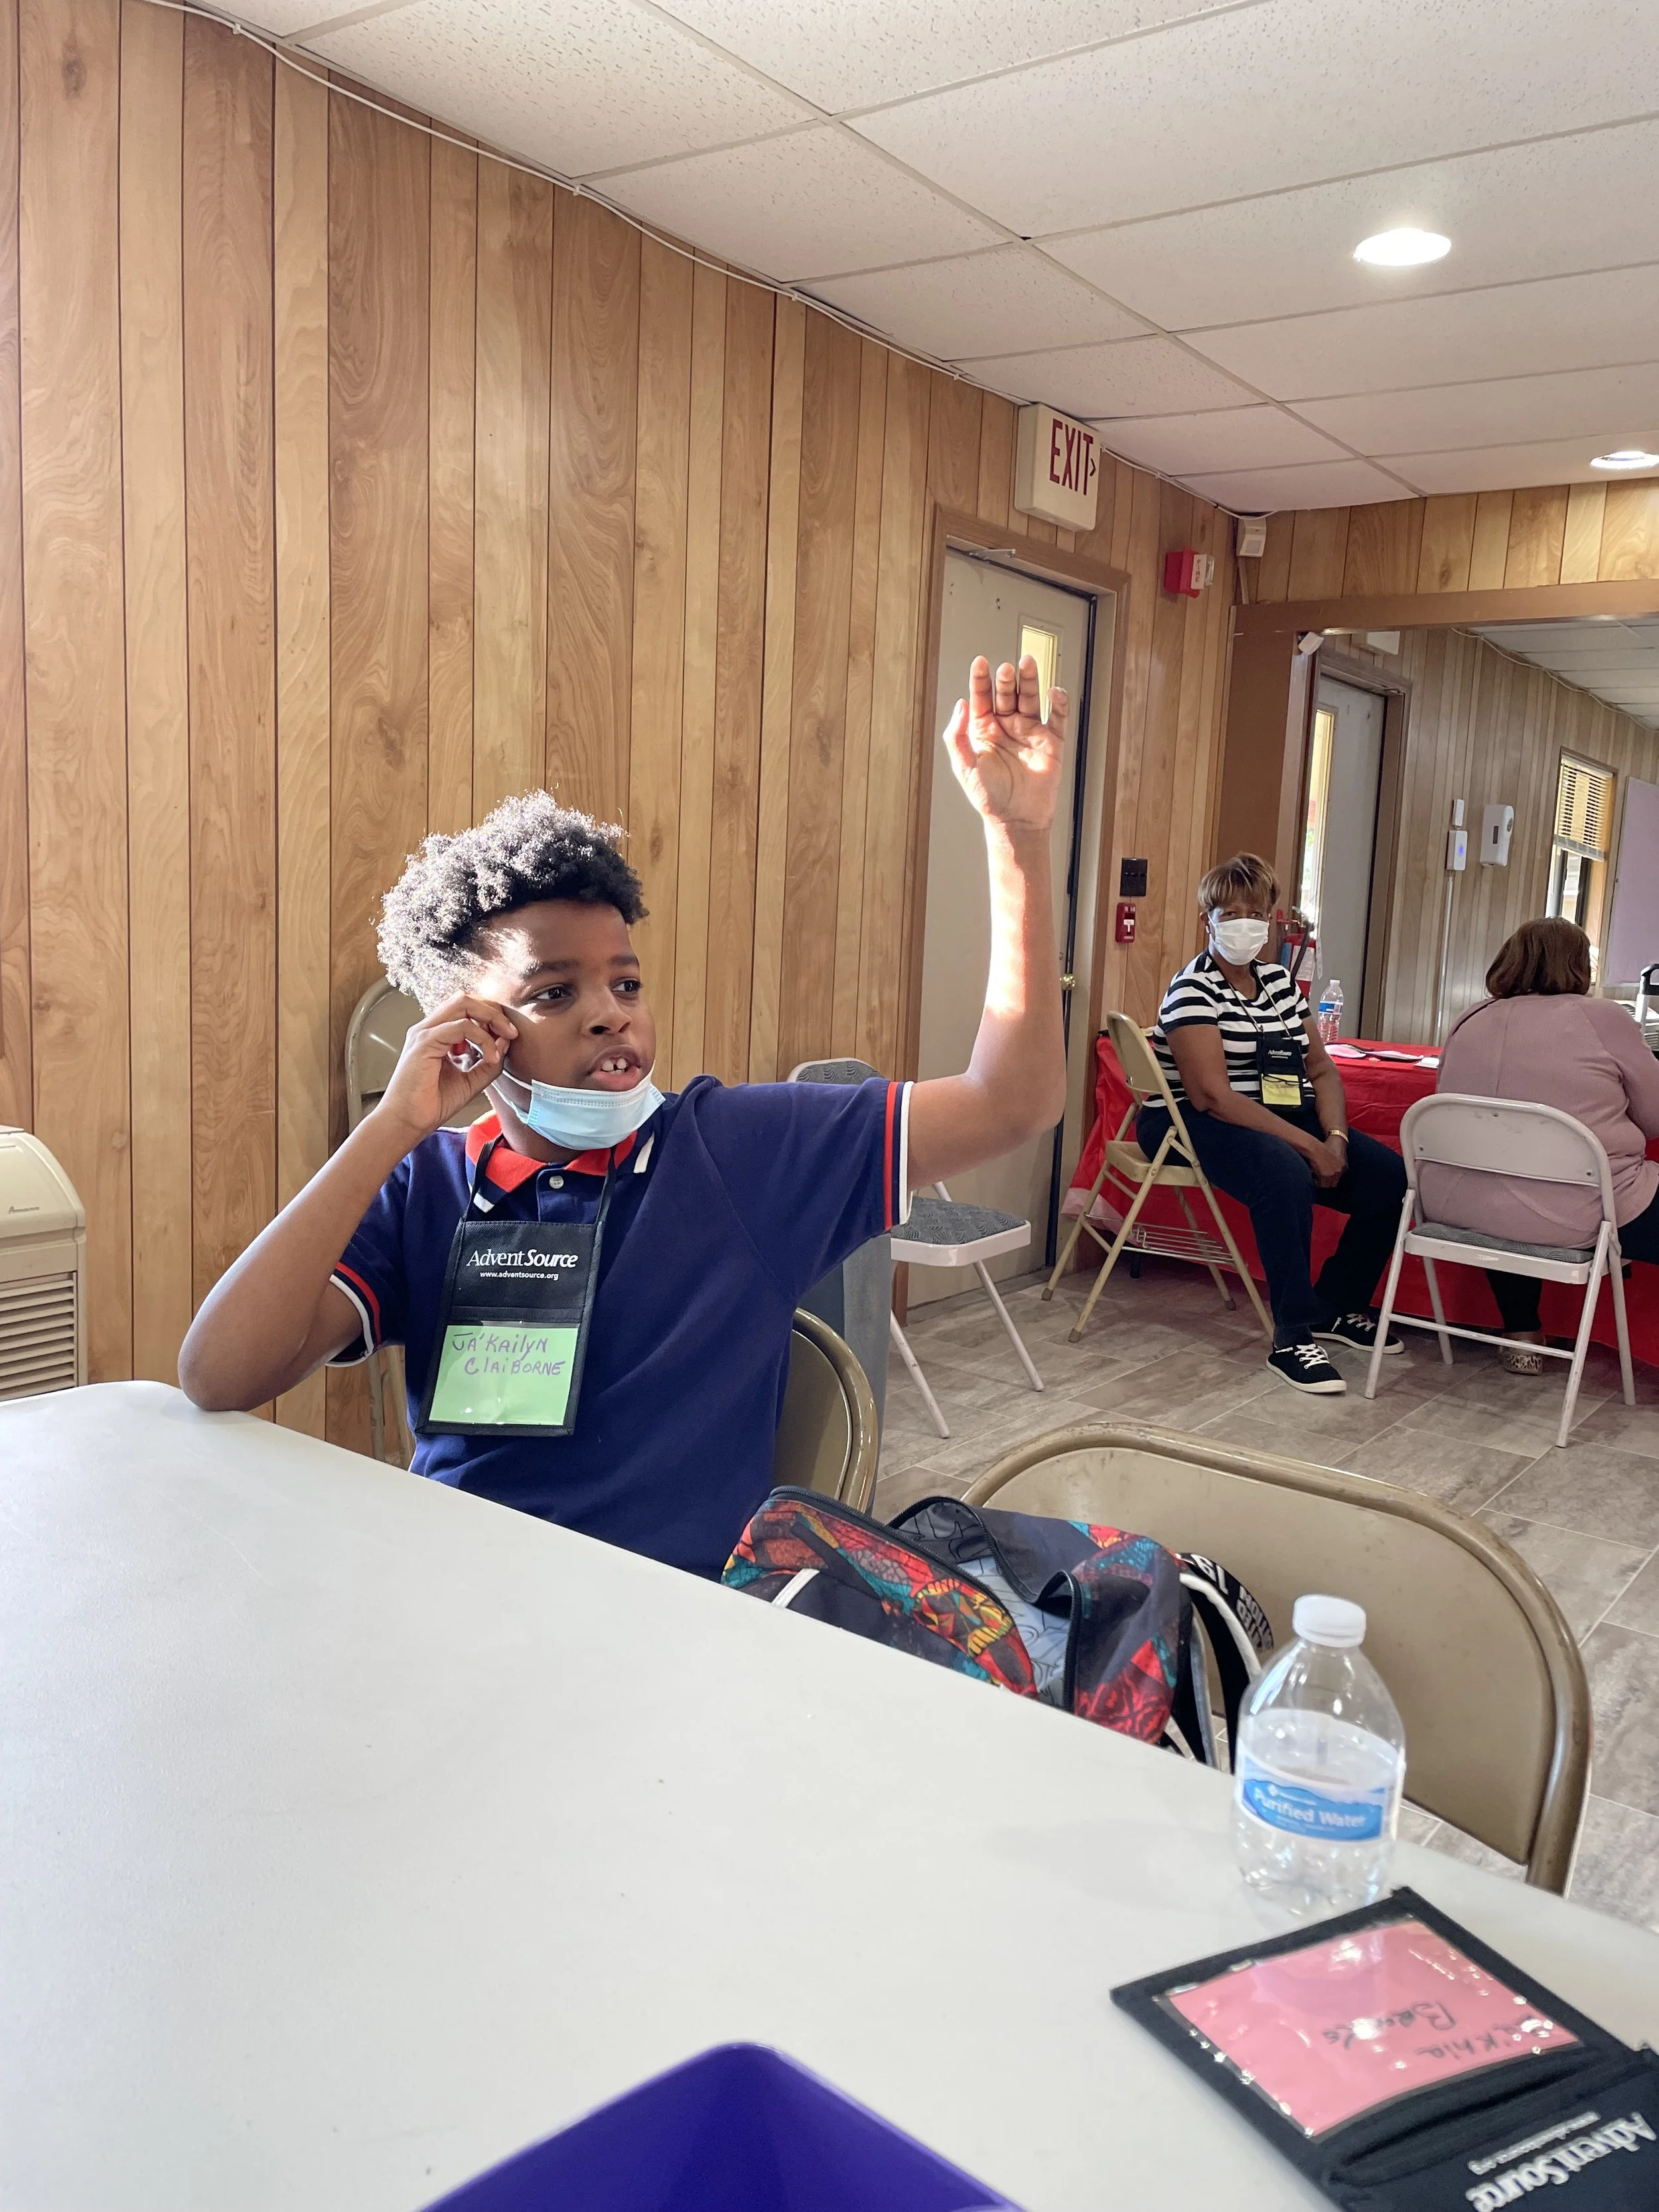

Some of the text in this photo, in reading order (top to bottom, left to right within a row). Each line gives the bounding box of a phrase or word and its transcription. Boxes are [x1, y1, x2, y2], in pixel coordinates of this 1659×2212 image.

[1050, 418, 1094, 496] EXIT
[466, 1248, 579, 1268] AdventSource
[480, 1270, 559, 1281] www.adventsource.org
[1254, 1787, 1315, 1822] Purified
[1318, 1810, 1366, 1827] Water
